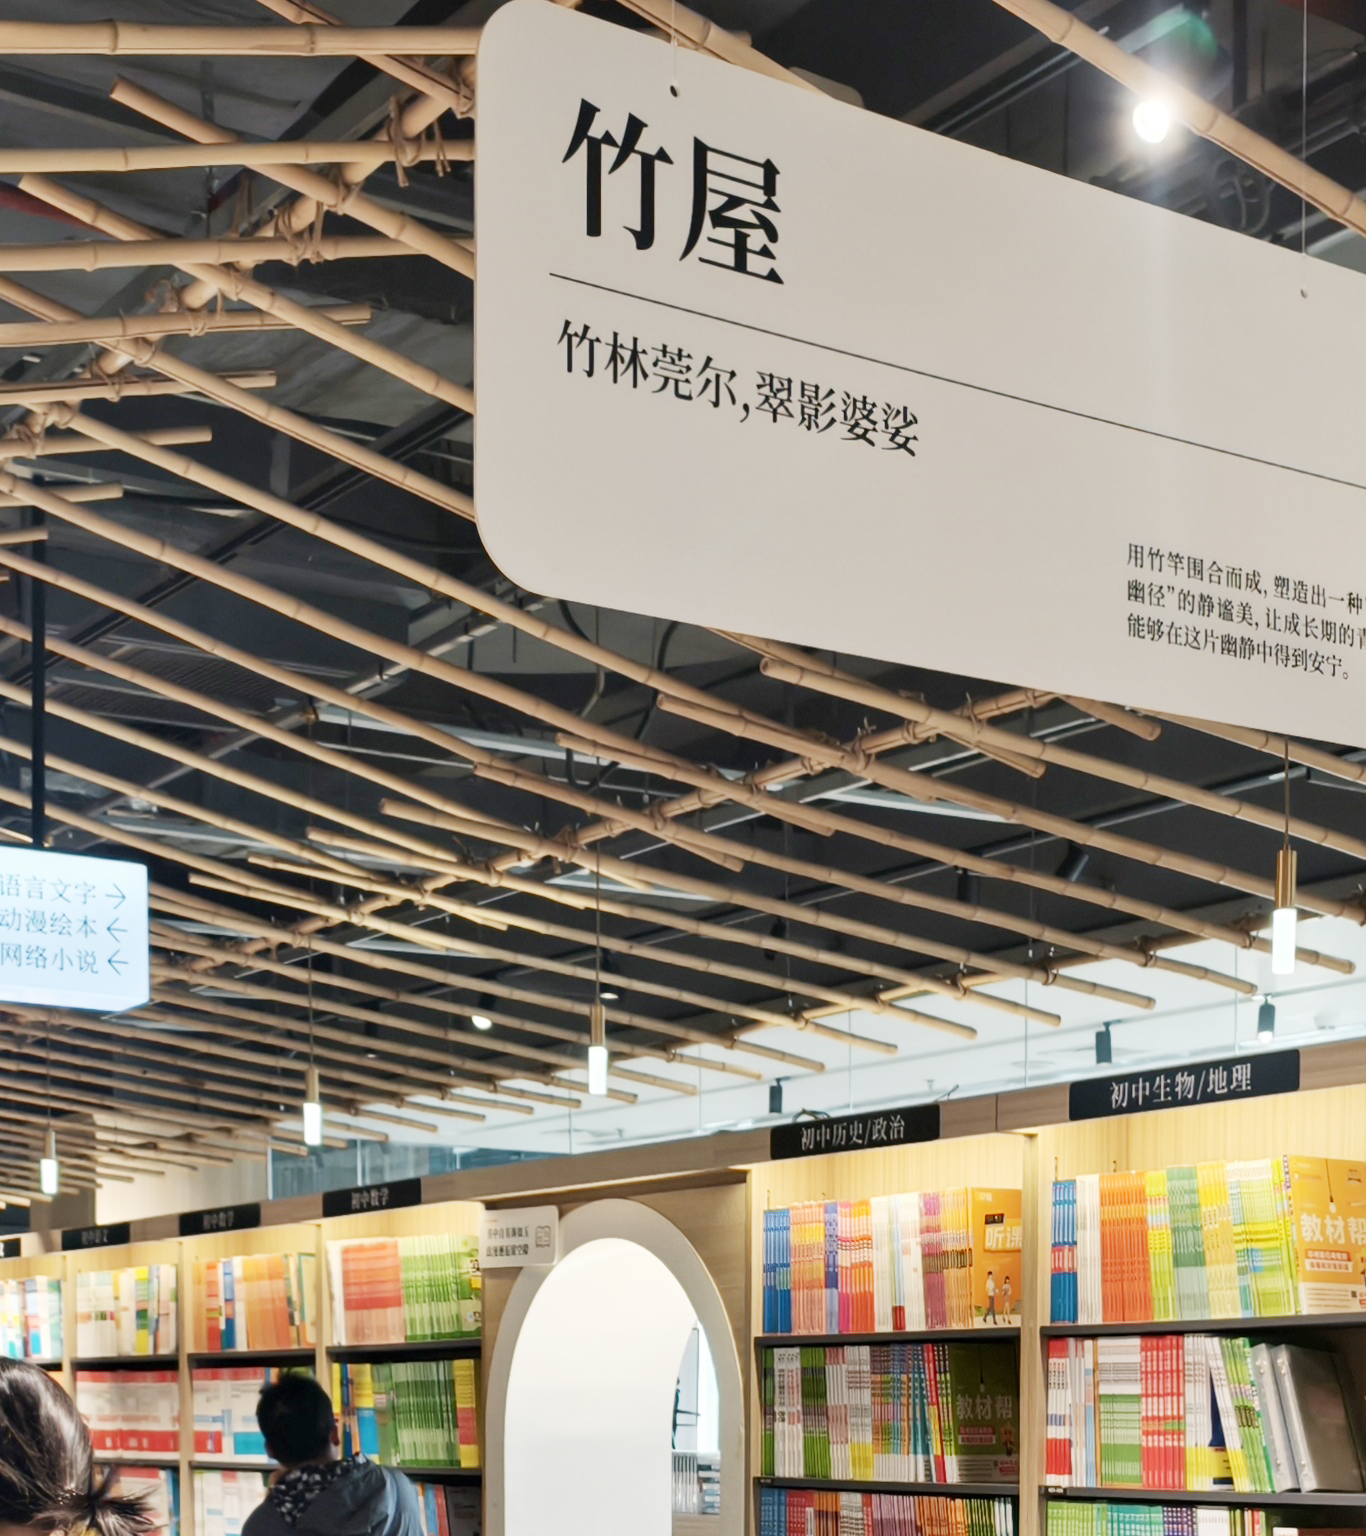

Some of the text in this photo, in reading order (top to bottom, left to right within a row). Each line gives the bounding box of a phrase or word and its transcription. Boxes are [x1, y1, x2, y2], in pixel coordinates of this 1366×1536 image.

[562, 99, 784, 284] 竹屋
[0, 874, 97, 904] 语言文字
[0, 908, 97, 938] 动漫绘本
[1110, 1063, 1252, 1109] 初中生物/地理
[800, 1115, 906, 1151] 初中历史/政治
[957, 1394, 1012, 1420] 教材帮
